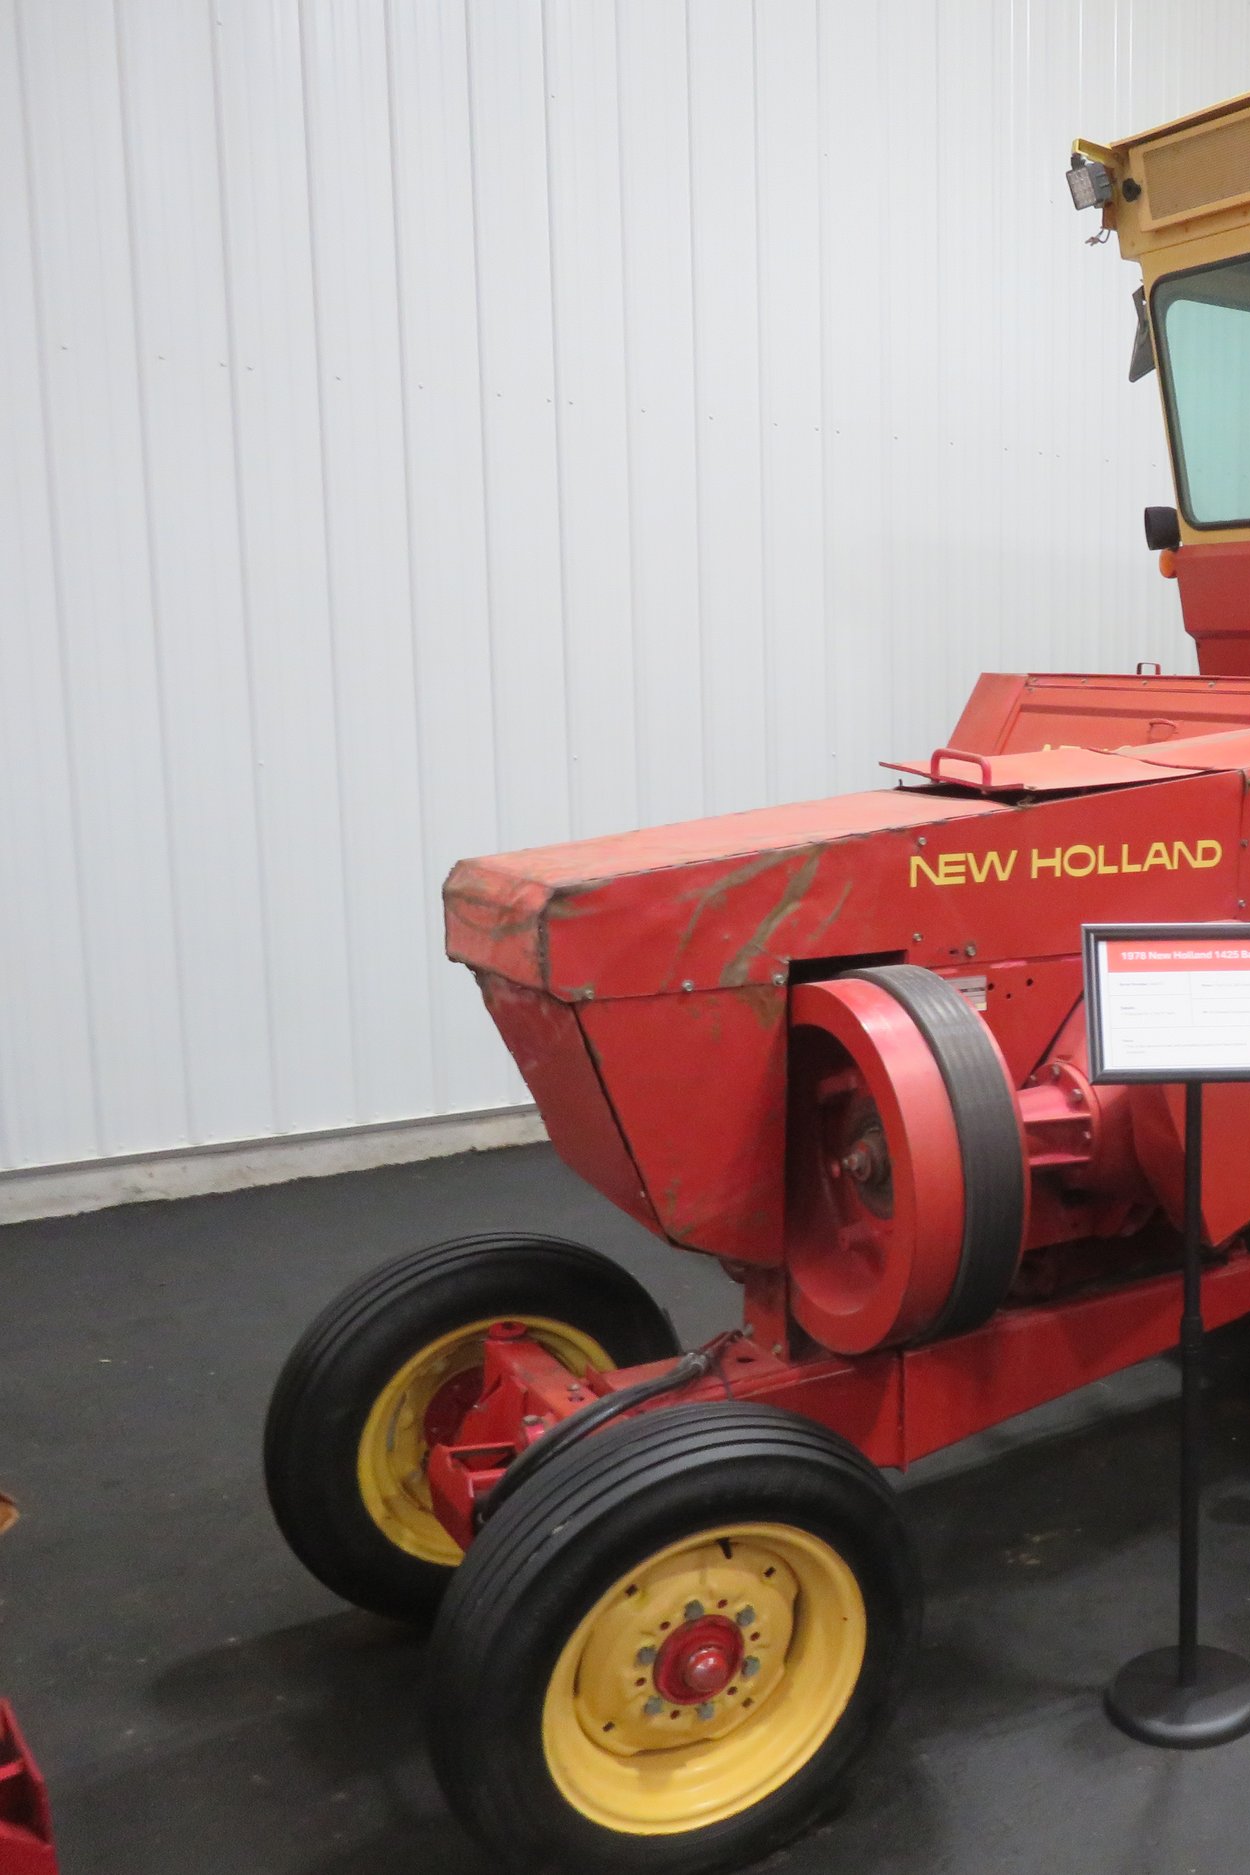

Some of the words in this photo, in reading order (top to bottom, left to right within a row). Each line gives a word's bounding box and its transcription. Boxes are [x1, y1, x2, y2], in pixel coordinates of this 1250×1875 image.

[910, 850, 1018, 888] NEW
[1031, 839, 1223, 879] HOLLAND
[1148, 951, 1172, 960] New
[1173, 950, 1213, 960] Holland
[1214, 950, 1240, 959] 1425
